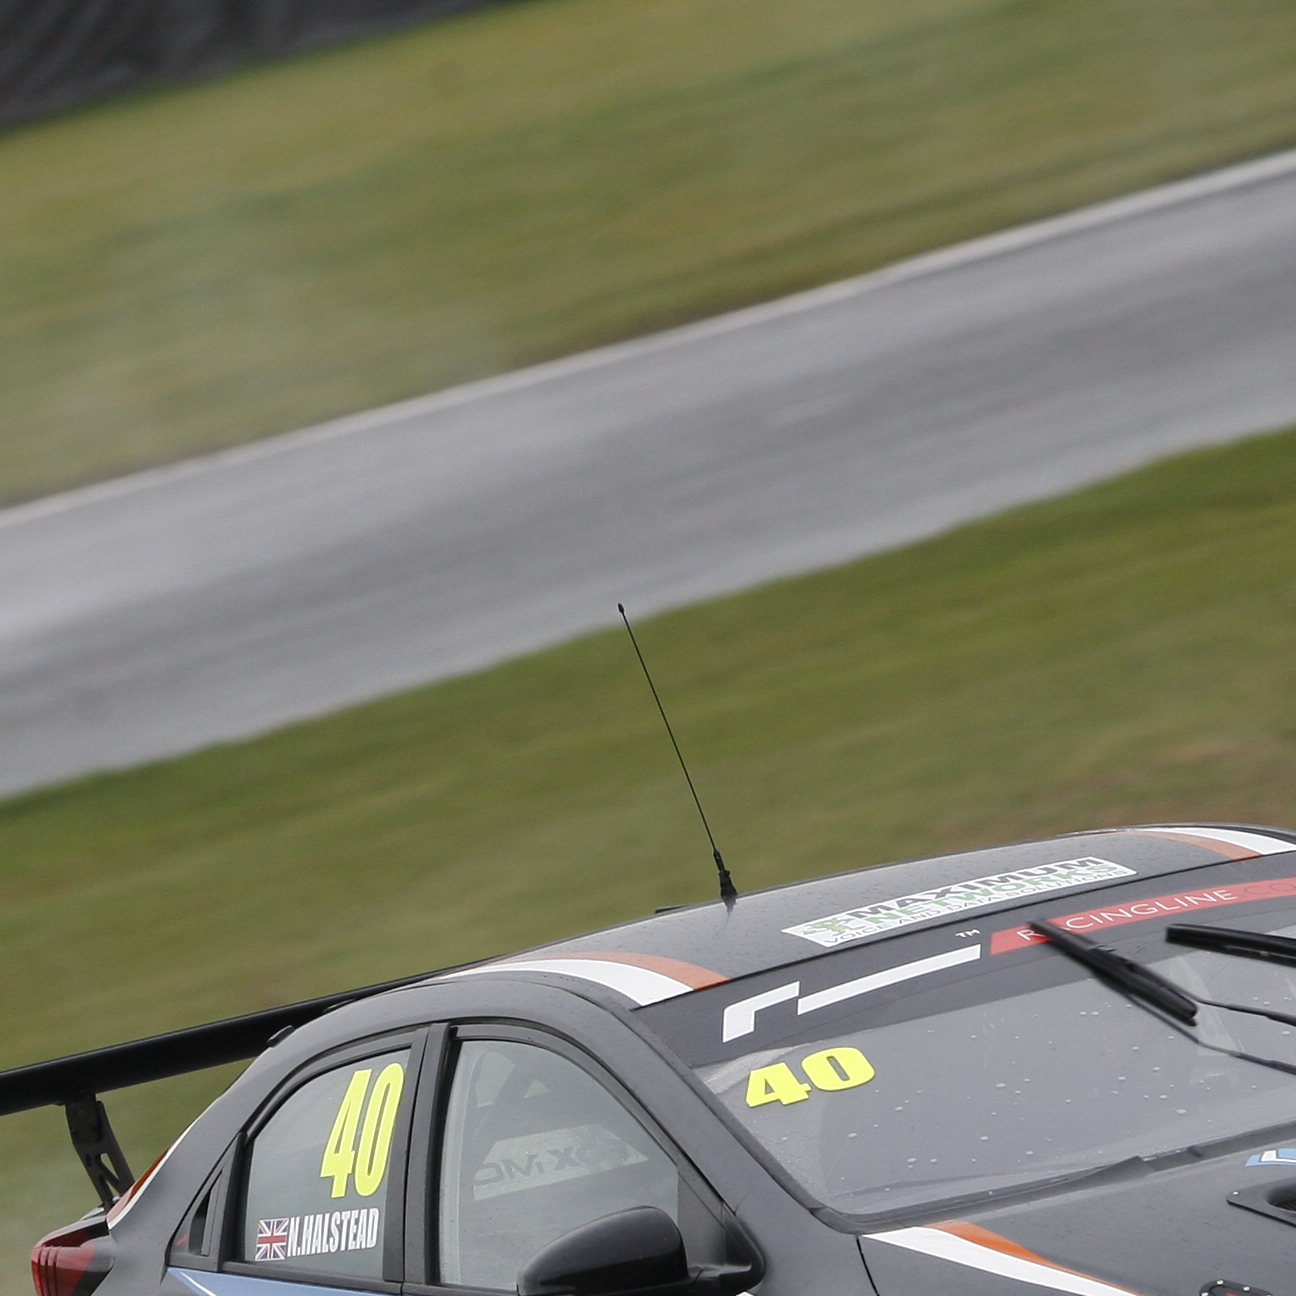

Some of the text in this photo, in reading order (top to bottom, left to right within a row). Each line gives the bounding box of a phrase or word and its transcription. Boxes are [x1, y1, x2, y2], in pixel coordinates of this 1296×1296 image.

[846, 858, 1102, 919] MAXIMUM
[864, 864, 1117, 925] NETWORKS
[898, 908, 942, 925] AND
[947, 894, 1002, 911] DATA
[1005, 870, 1129, 897] SOLUTIONS
[745, 1046, 876, 1108] 40
[320, 1063, 404, 1198] 40
